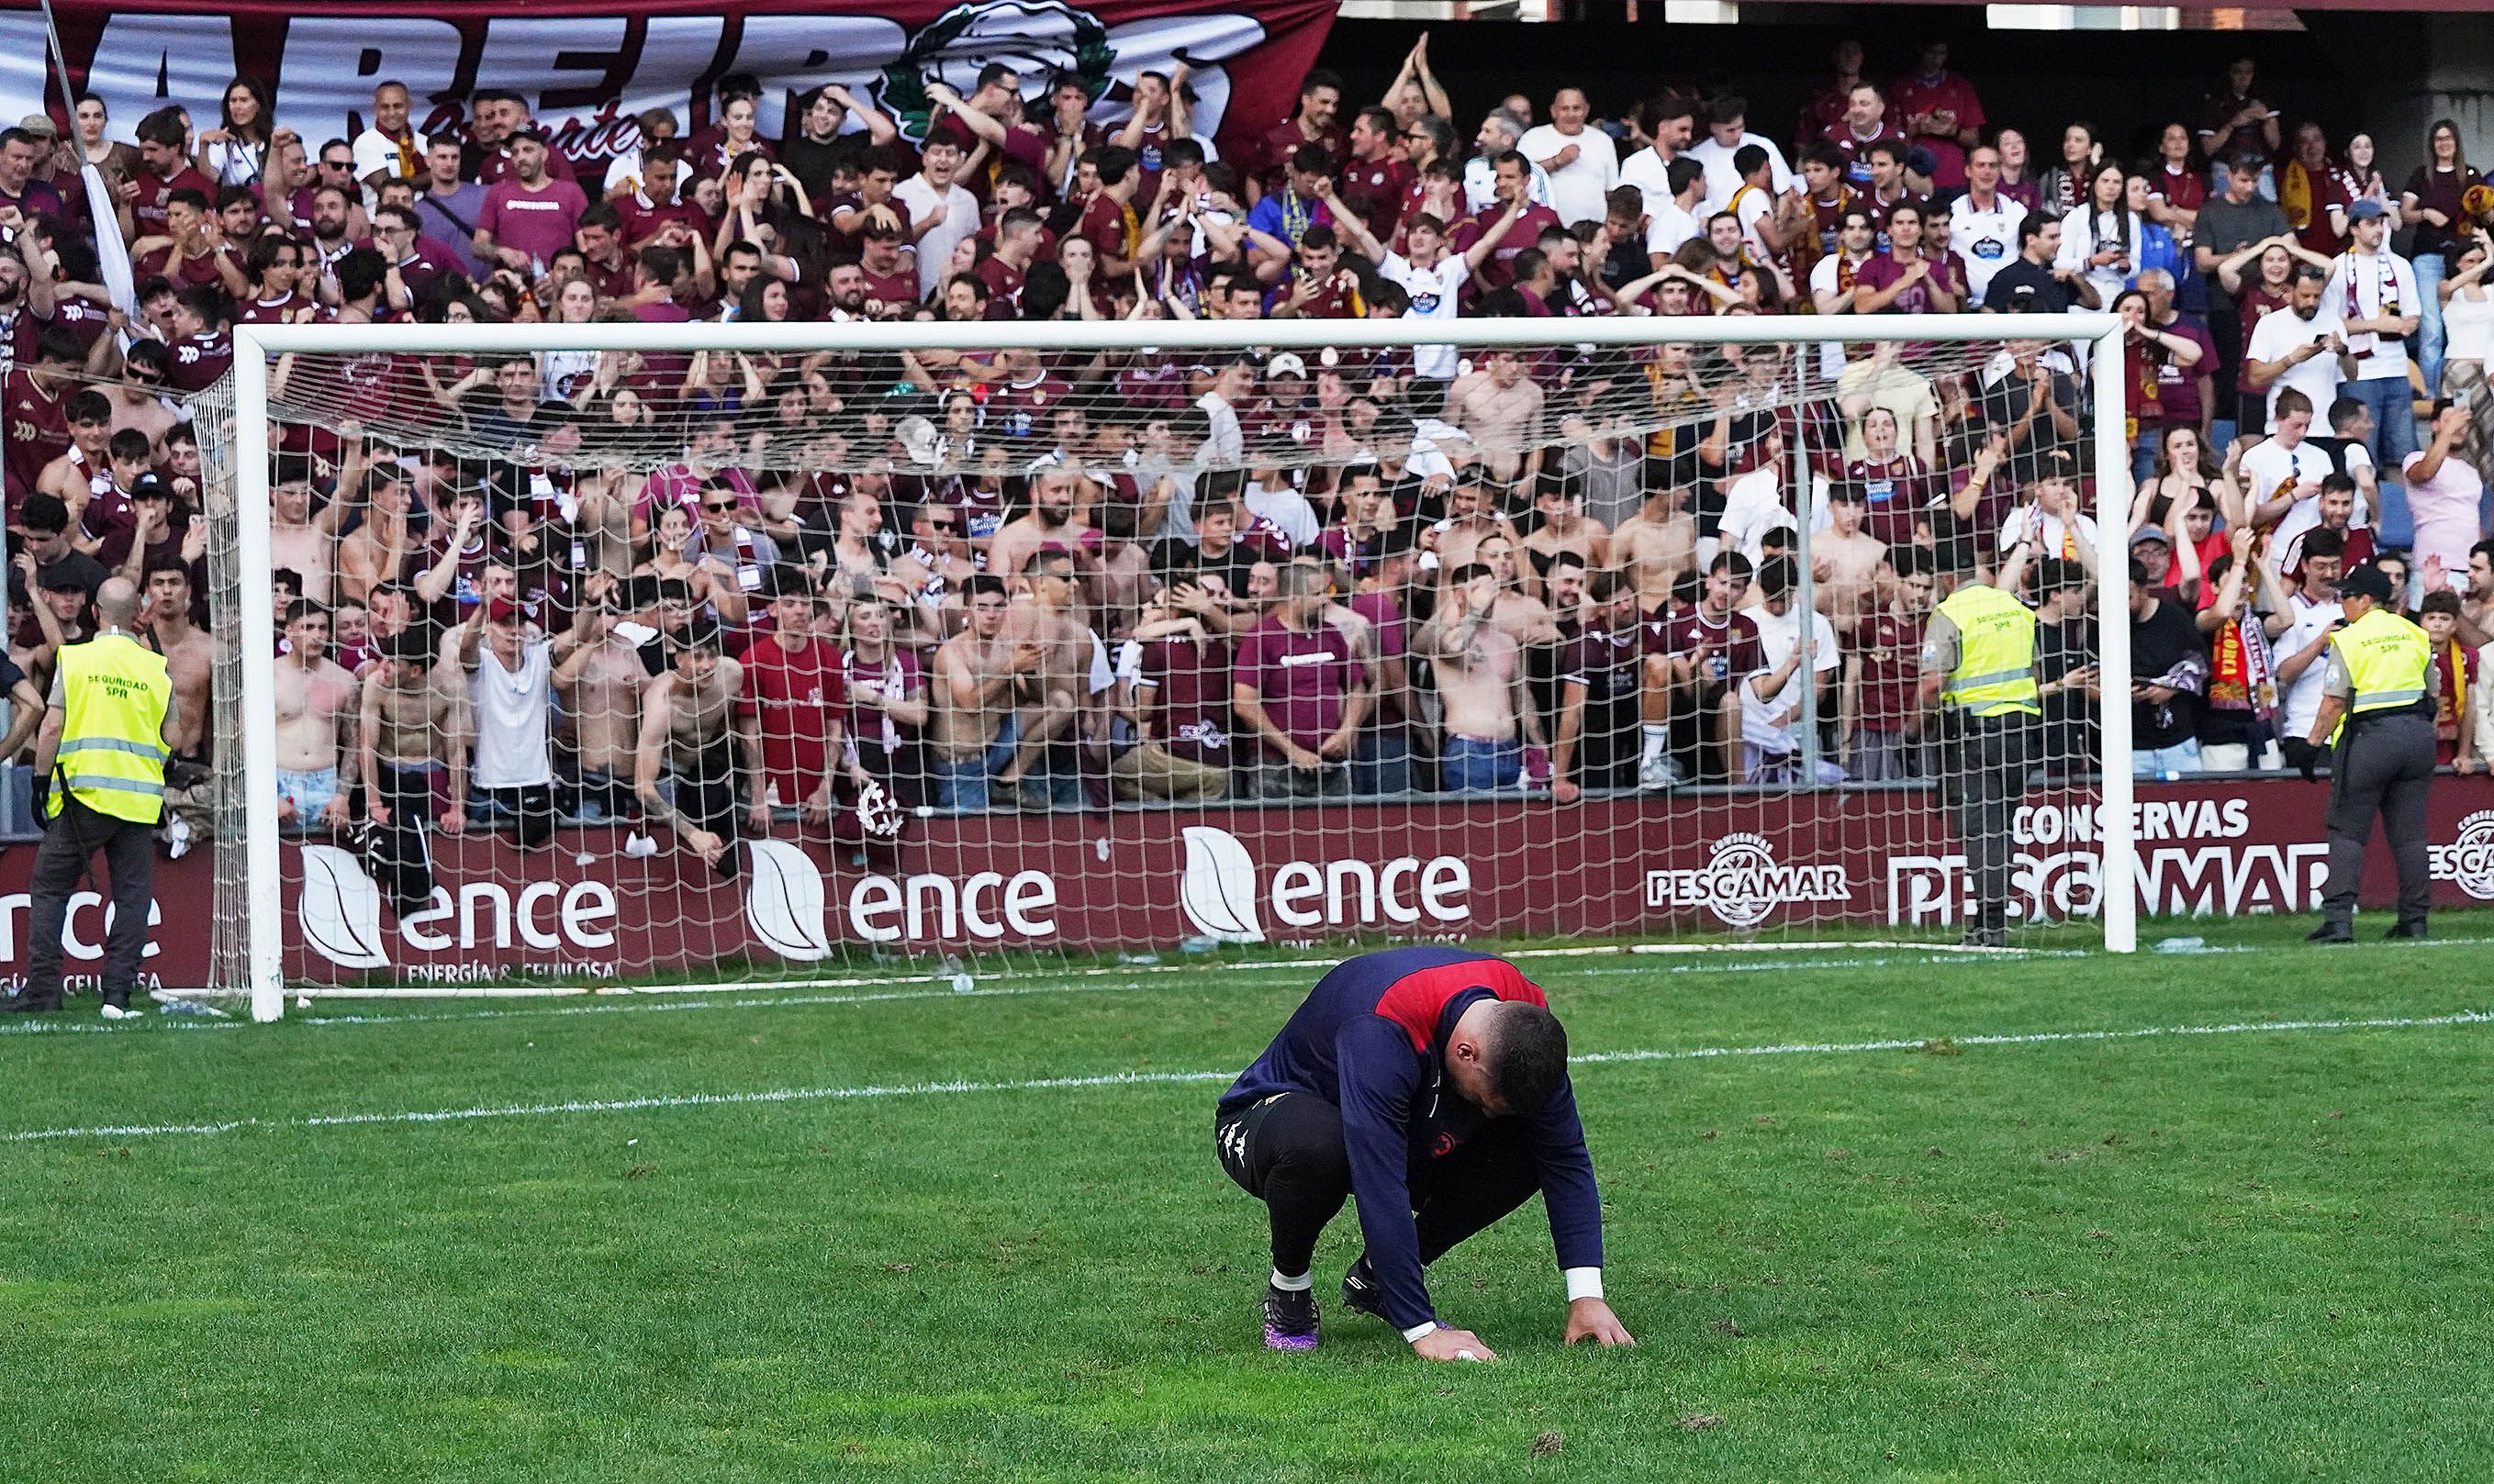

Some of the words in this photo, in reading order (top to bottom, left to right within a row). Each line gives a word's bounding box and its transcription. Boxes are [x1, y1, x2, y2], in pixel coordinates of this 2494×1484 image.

[87, 675, 148, 691] SEGURIDAD
[106, 686, 128, 698] SPR
[849, 870, 1056, 941] ence
[1271, 855, 1471, 927] ence
[1647, 865, 1851, 907] PESCAMAR
[400, 880, 617, 951] ence
